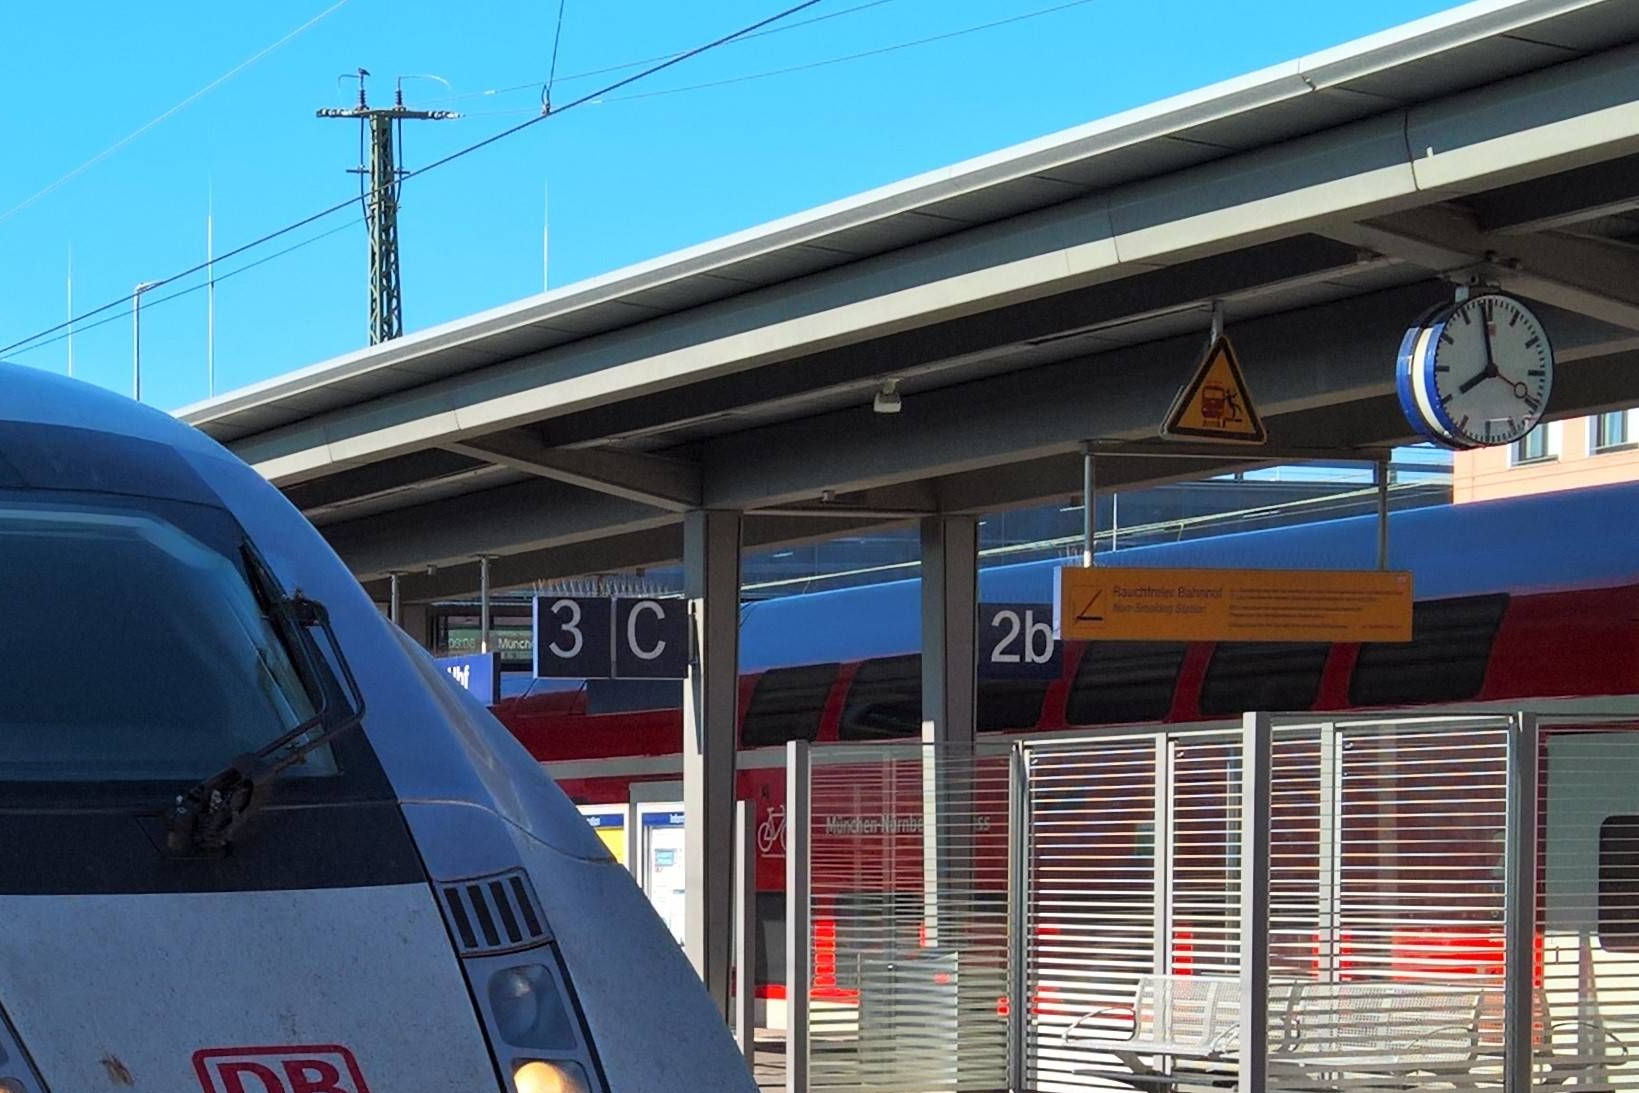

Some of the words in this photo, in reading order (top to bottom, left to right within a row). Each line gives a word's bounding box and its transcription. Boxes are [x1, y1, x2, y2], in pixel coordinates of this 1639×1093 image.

[498, 638, 534, 649] Münch
[548, 599, 584, 659] 3
[627, 600, 666, 660] C
[991, 609, 1054, 663] 2b
